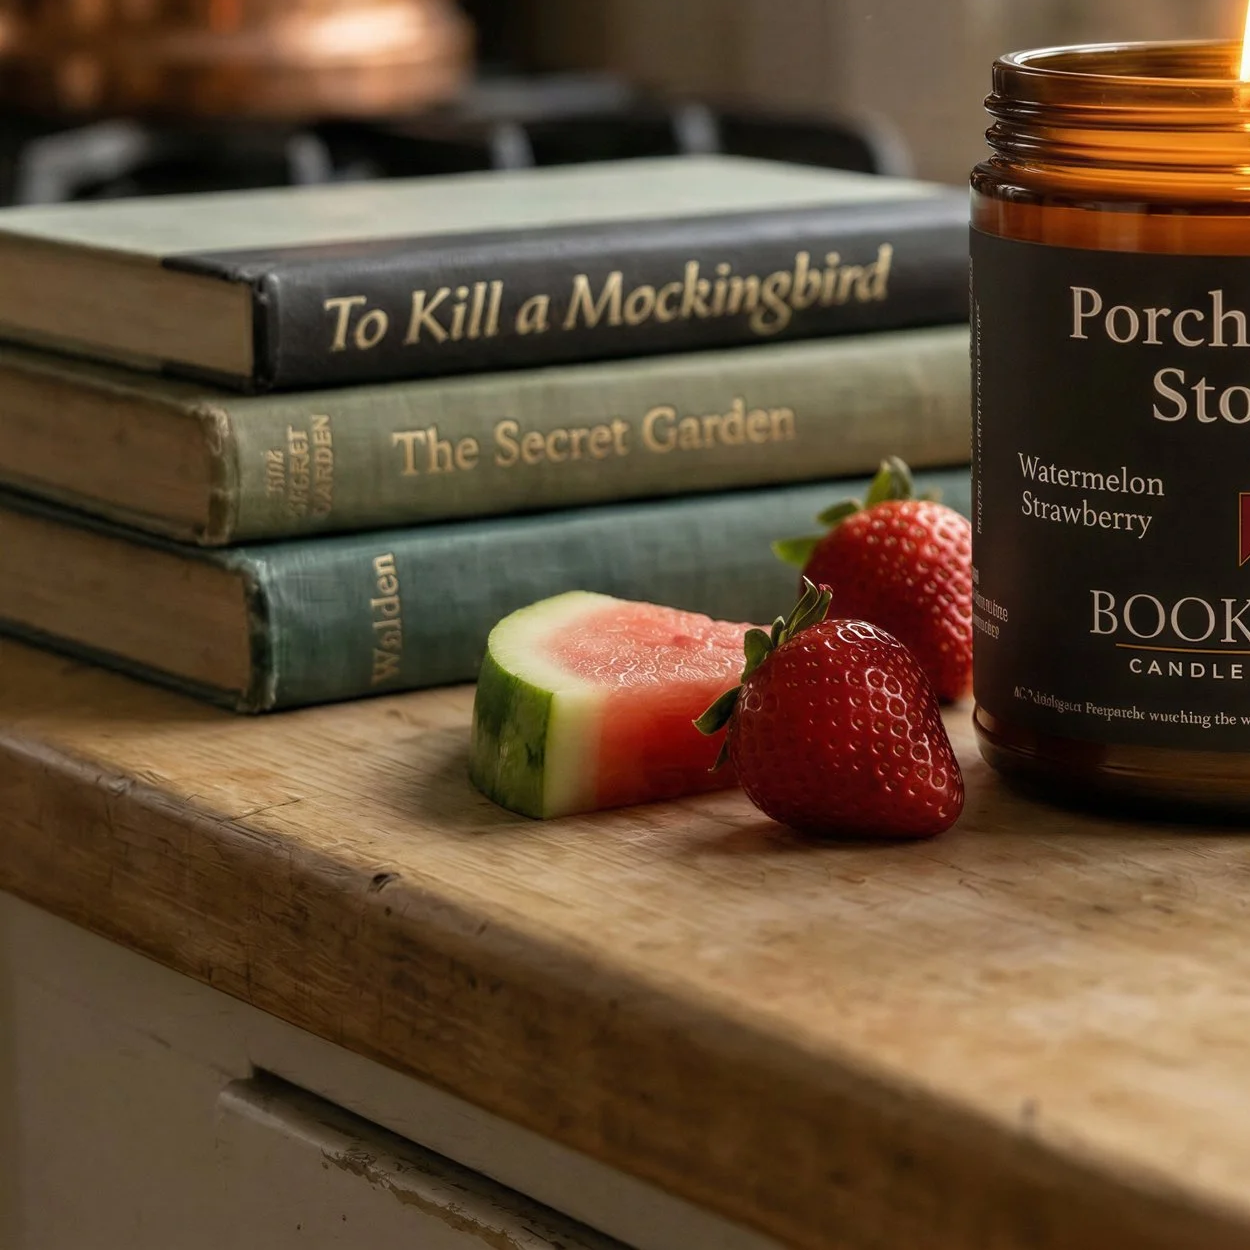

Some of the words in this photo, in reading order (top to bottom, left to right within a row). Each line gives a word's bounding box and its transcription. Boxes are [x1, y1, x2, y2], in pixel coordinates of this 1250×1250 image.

[324, 295, 388, 350] To
[404, 280, 503, 346] Kill
[516, 294, 550, 335] a
[564, 243, 893, 335] Mockingbird
[393, 426, 479, 478] The
[493, 417, 631, 470] Secret
[642, 398, 796, 453] Garden
[1017, 452, 1165, 496] Watermelon
[1021, 490, 1153, 540] Strawberry
[370, 552, 402, 687] Walden
[1129, 658, 1243, 680] CANDLE
